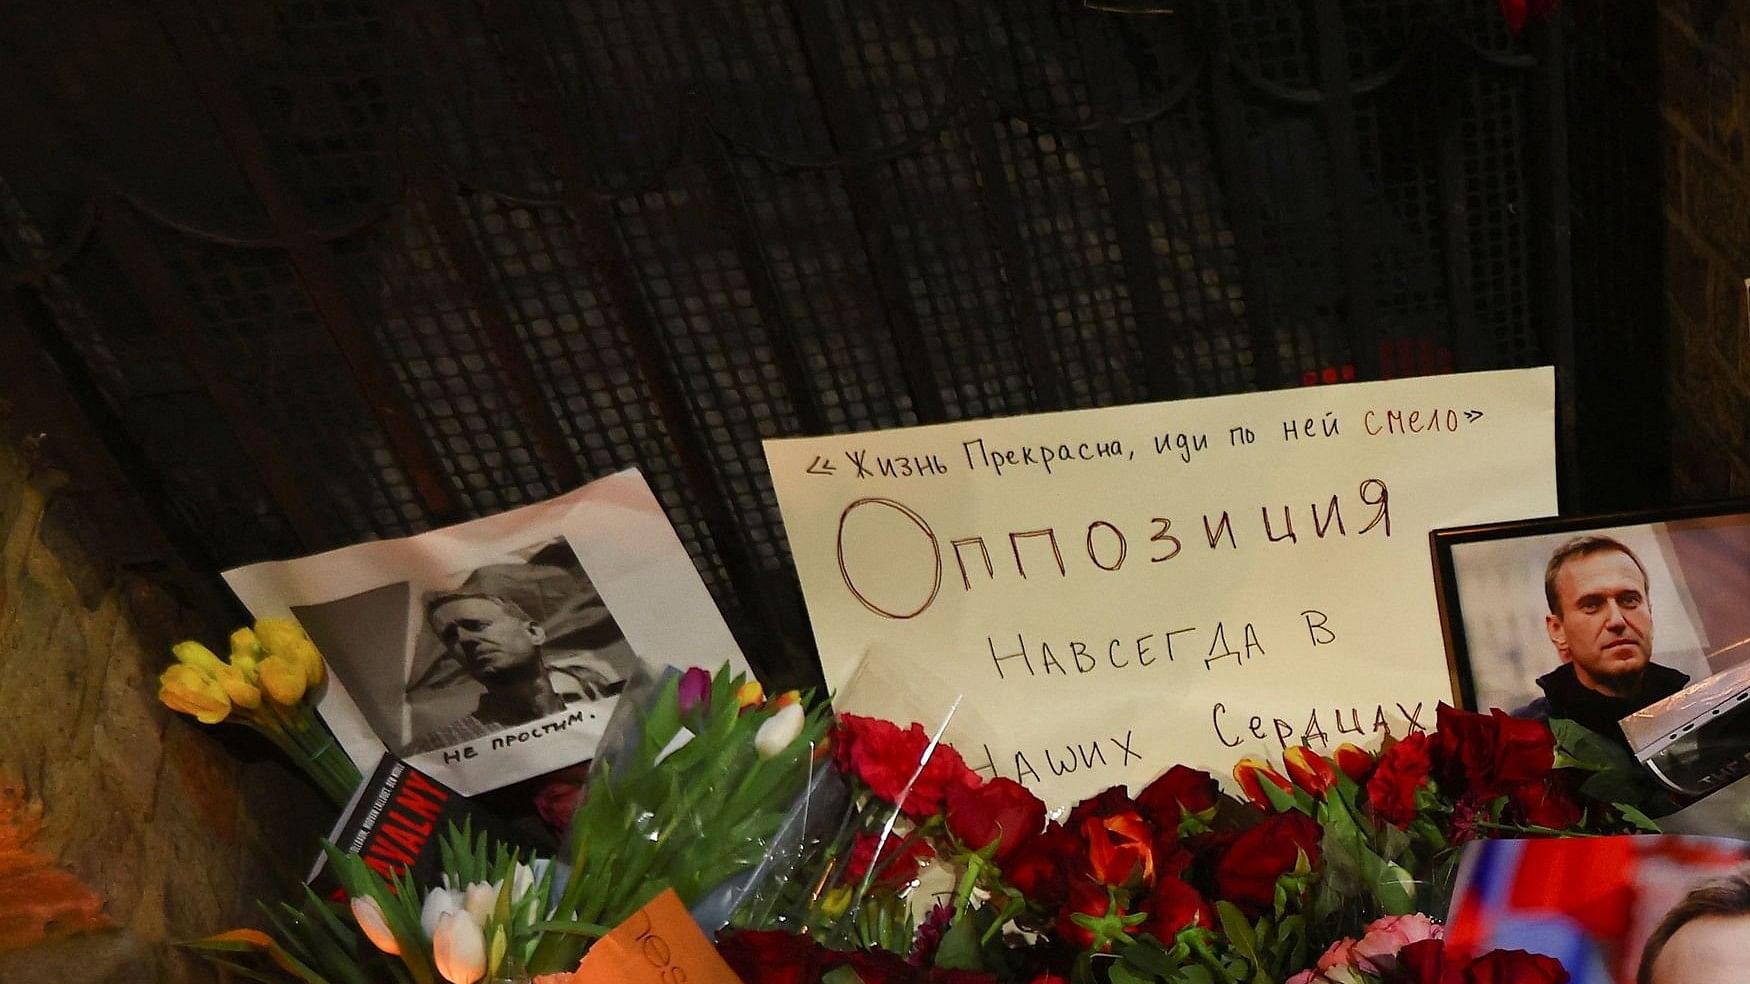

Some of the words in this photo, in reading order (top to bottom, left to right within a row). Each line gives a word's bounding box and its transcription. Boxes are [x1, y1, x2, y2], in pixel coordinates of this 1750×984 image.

[1154, 432, 1208, 467] иди
[1229, 425, 1256, 446] по
[1283, 413, 1340, 442] ней
[443, 747, 478, 764] НЕ
[350, 768, 450, 890] AVALNY
